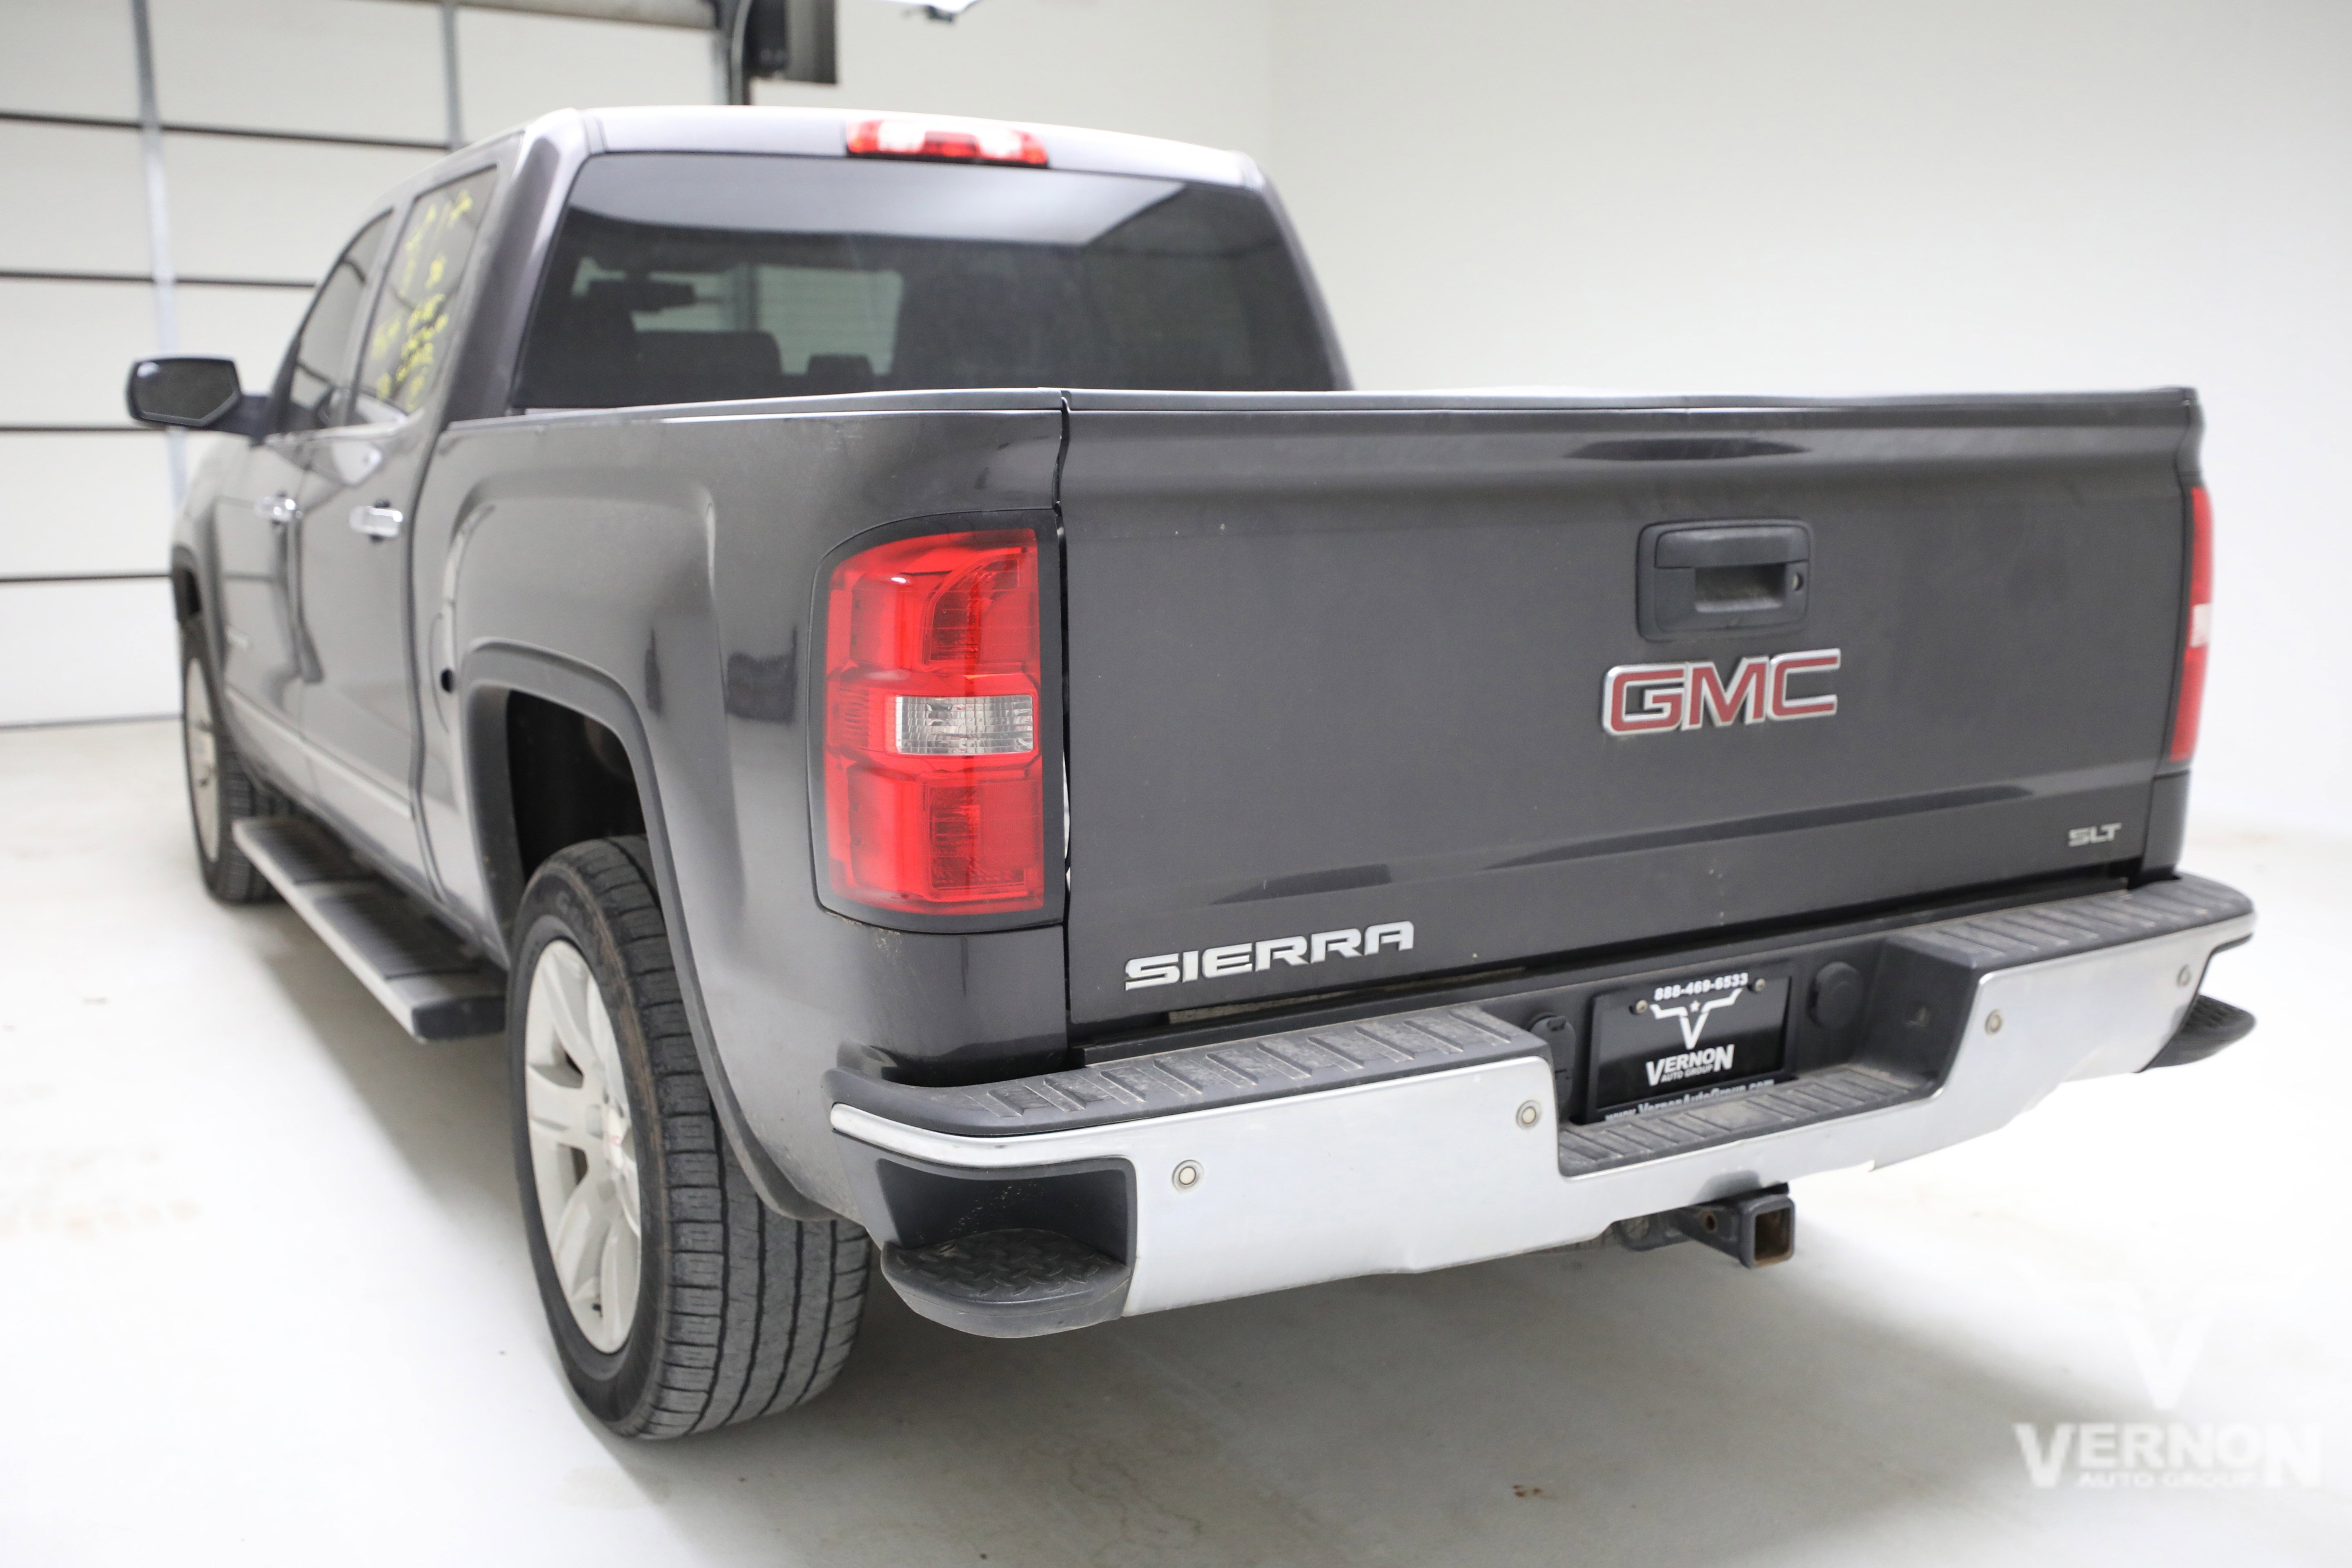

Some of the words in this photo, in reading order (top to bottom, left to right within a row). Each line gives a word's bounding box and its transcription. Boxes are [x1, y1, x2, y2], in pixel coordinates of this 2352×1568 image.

[1602, 648, 1840, 736] GMC
[2067, 822, 2123, 848] SLT
[1125, 920, 1414, 991] SIERRA
[1654, 972, 1749, 1002] 888-469-6533
[1646, 1044, 1735, 1087] VERNON
[1660, 1070, 1684, 1083] AUTO
[1684, 1064, 1713, 1078] GROUP
